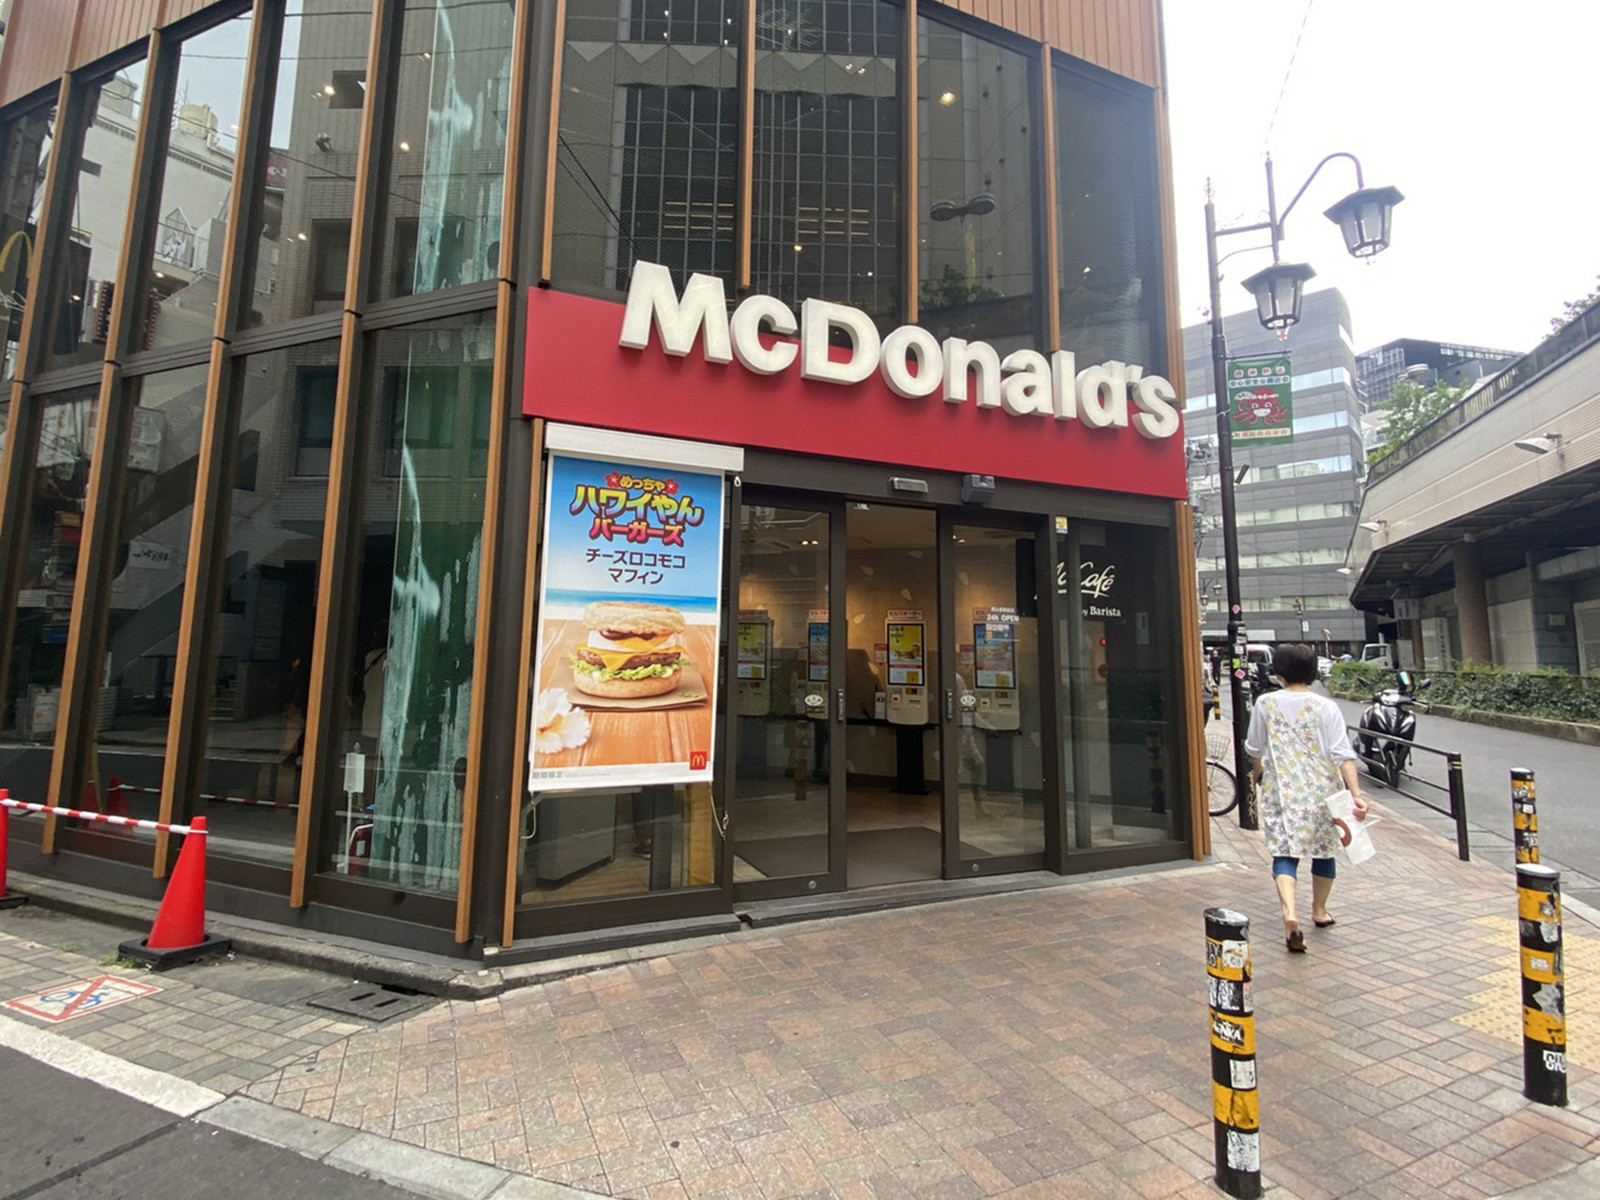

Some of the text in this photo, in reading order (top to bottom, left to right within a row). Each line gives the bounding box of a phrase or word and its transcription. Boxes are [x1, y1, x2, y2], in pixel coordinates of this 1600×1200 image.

[619, 260, 1179, 439] McDonald's
[619, 475, 666, 492] めっちゃ
[570, 485, 704, 526] ハワイやん
[589, 517, 685, 547] バーガーズ
[586, 548, 686, 569] チーズロコモコ
[608, 568, 664, 585] マフィン
[987, 614, 1020, 623] 24h OPEN
[1089, 605, 1121, 617] Barista
